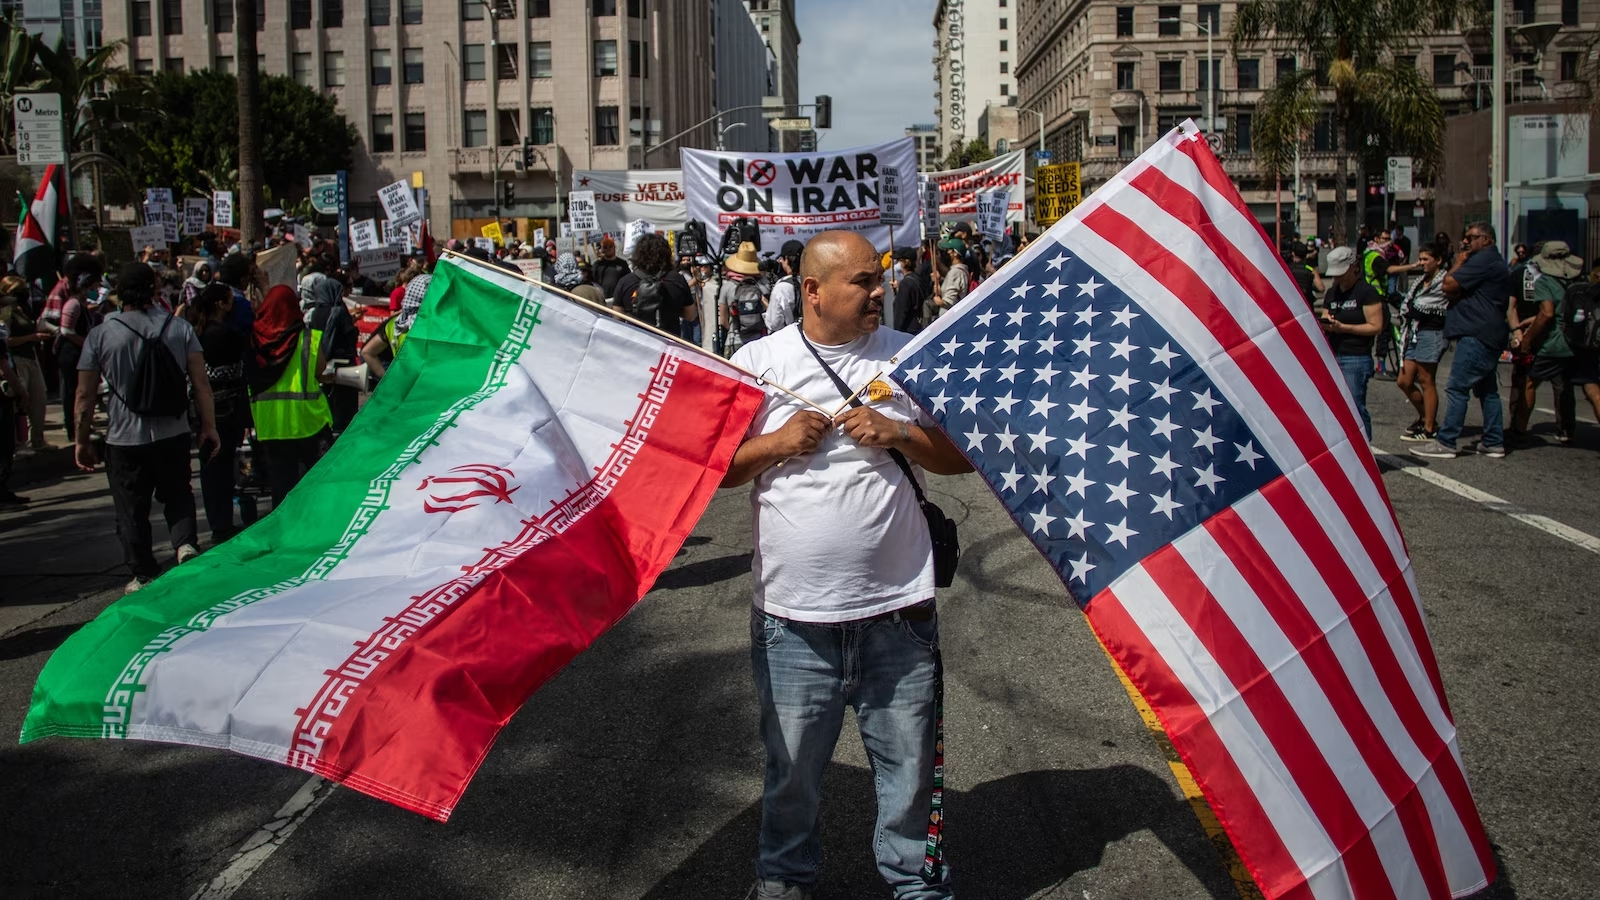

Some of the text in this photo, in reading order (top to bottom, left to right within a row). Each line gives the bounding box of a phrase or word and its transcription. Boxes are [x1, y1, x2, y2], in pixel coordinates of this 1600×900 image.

[948, 0, 962, 130] OTEL CLARK
[18, 132, 29, 140] 10
[719, 153, 878, 186] NO WAR
[882, 168, 898, 176] HANDS
[934, 172, 970, 182] UNITED
[939, 172, 1021, 192] MIGRANT
[1038, 172, 1076, 182] PEOPLE'S
[382, 183, 402, 195] HANDS
[637, 182, 678, 192] VETS
[882, 185, 898, 194] IRAN!
[1038, 181, 1077, 195] NEEDS
[388, 195, 406, 207] IRAN!
[594, 193, 630, 202] FUSE
[634, 192, 685, 202] UNLAW
[716, 182, 879, 213] ON IRAN
[1039, 194, 1078, 208] NOT WAR
[216, 200, 226, 208] STOP
[392, 203, 408, 213] HANDS
[571, 200, 588, 211] STOP
[978, 203, 991, 213] STO
[186, 208, 200, 216] STOP
[773, 214, 833, 224] GENOCIDE
[850, 209, 880, 219] GAZA
[354, 222, 369, 230] HANDS
[384, 228, 402, 238] STOP
